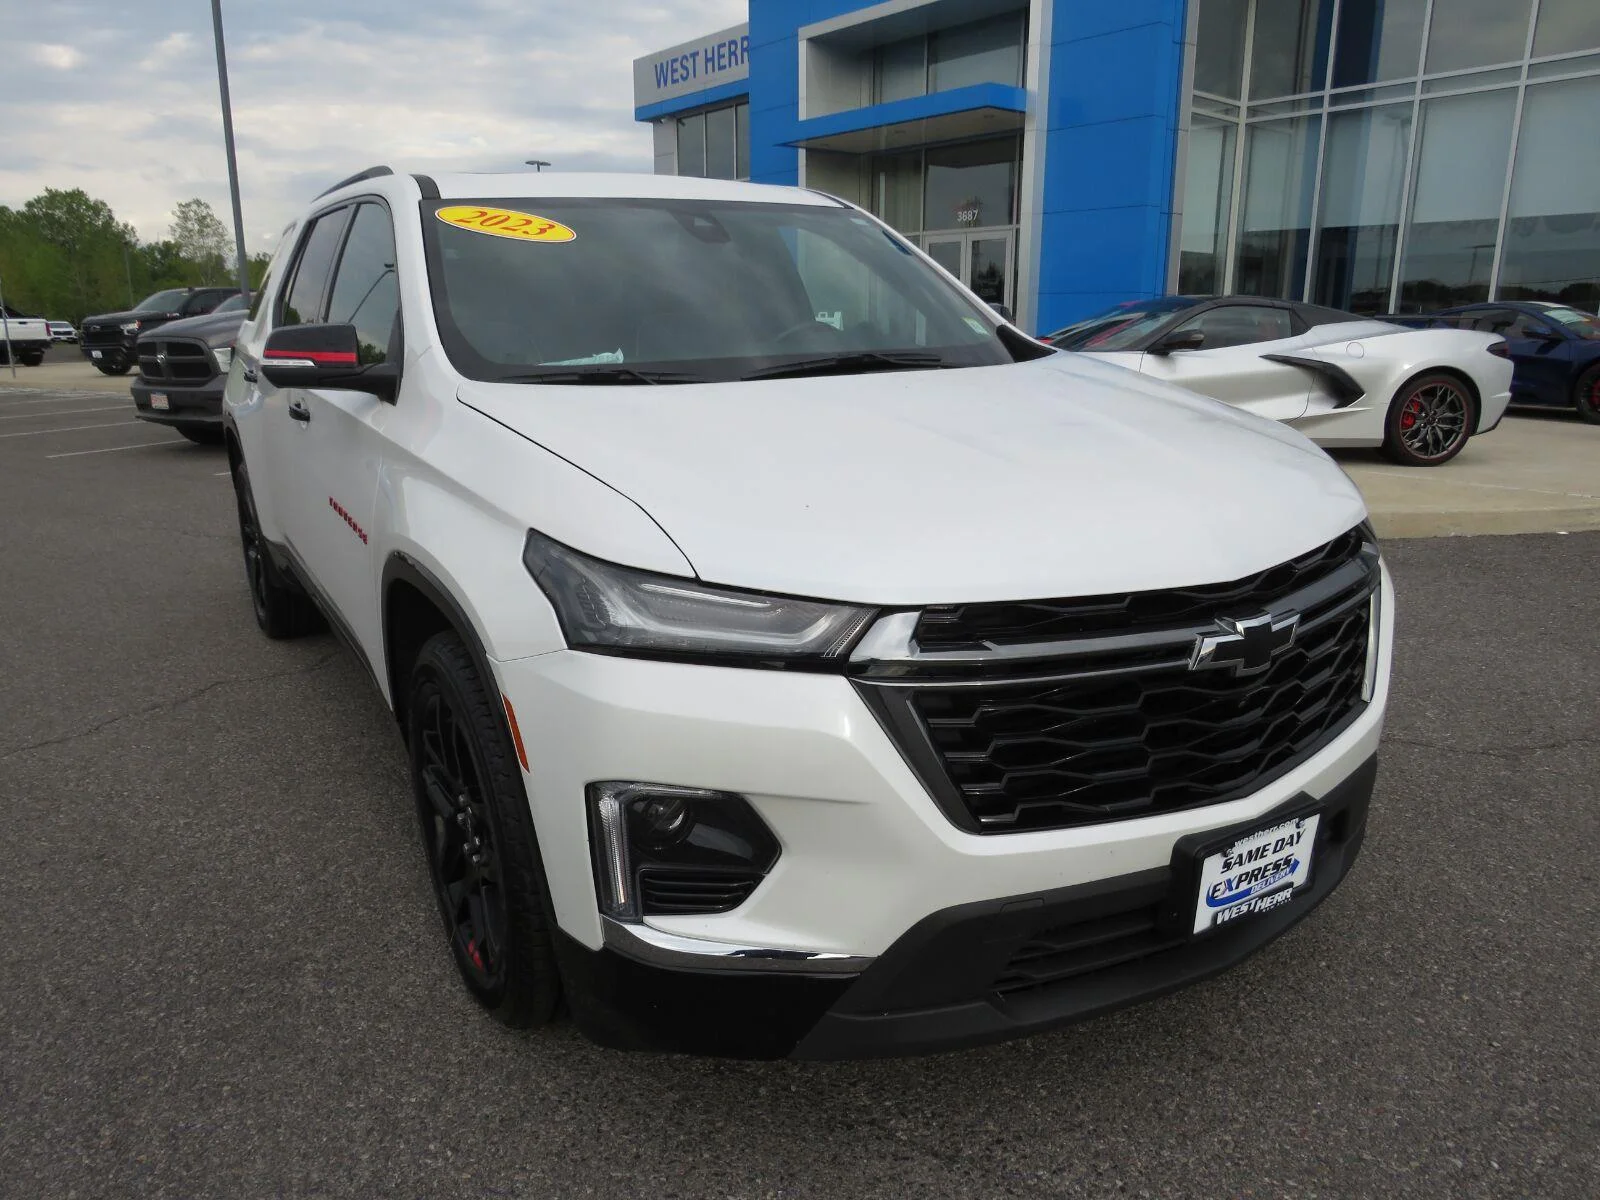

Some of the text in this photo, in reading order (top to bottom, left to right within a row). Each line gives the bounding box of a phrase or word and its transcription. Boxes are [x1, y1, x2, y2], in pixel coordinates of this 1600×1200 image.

[654, 35, 749, 89] WEST HERR
[454, 210, 556, 236] 2023
[957, 209, 979, 221] 3687
[1221, 828, 1306, 874] SAME DAY
[1211, 853, 1294, 899] EXPRESS
